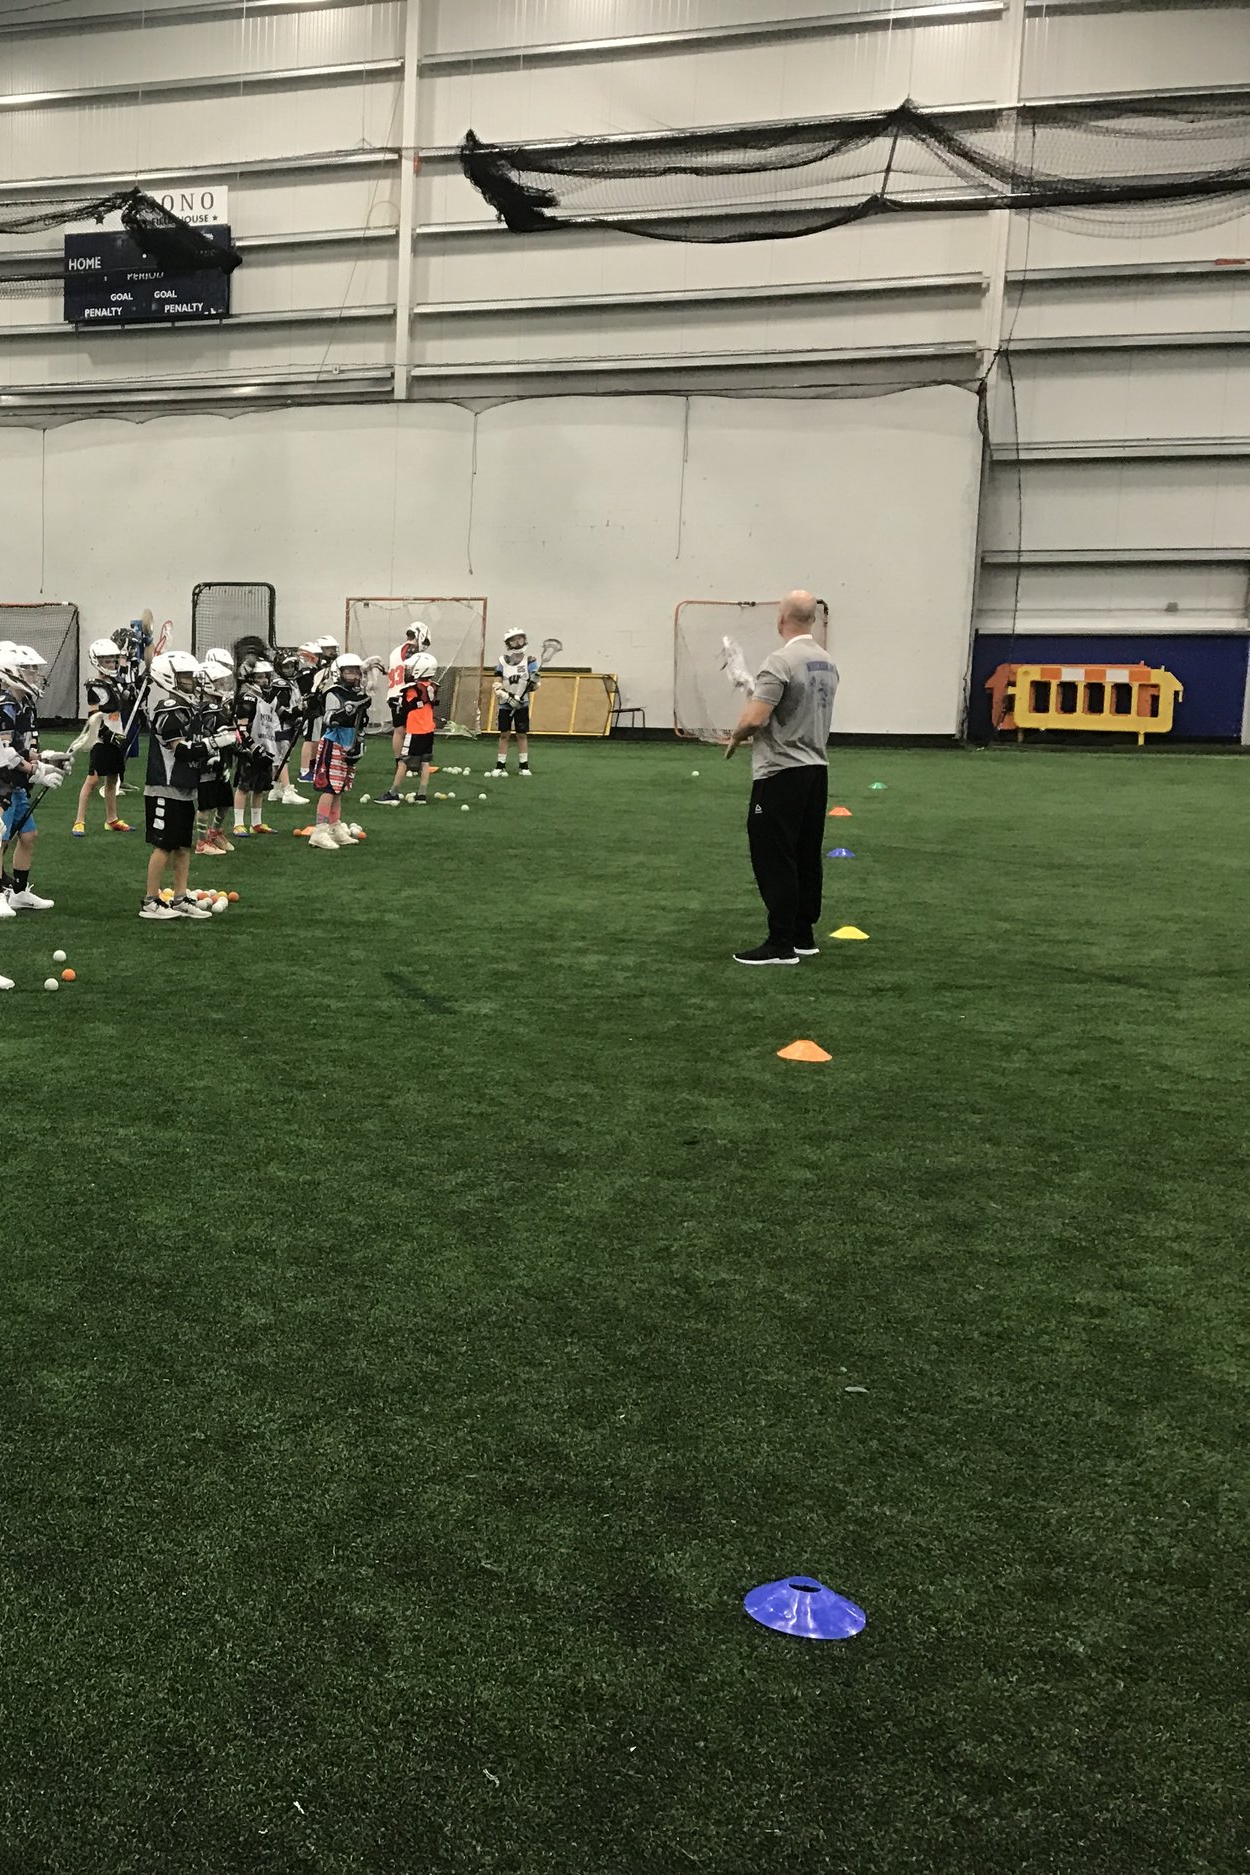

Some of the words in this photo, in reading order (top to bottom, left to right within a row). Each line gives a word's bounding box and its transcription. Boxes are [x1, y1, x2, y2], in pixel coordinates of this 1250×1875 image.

[182, 214, 209, 224] OUSE
[68, 256, 102, 271] HOME
[110, 292, 134, 301] GOAL
[154, 289, 178, 299] GOAL
[84, 307, 123, 318] PENALTY
[164, 302, 204, 313] PENALTY
